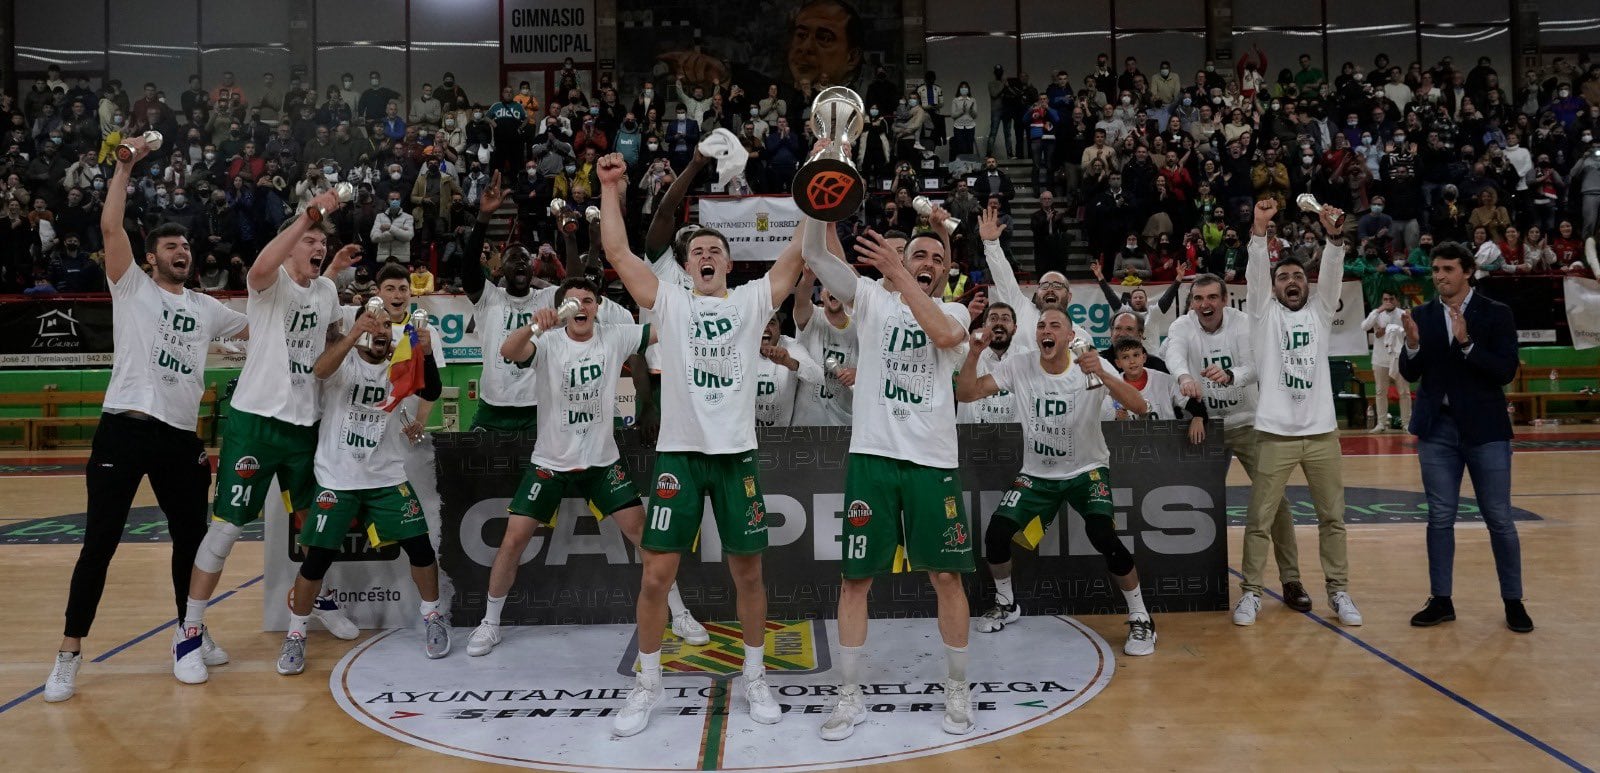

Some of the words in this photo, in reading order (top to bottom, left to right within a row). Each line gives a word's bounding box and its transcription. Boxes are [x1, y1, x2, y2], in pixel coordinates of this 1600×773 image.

[511, 8, 585, 27] GIMNASIO
[510, 34, 592, 53] MUNICIPAL
[705, 221, 756, 229] AYUNTAMIENTO
[694, 346, 732, 358] SOMOS
[888, 326, 928, 362] LEB
[87, 354, 100, 362] 942
[886, 358, 927, 374] SOMOS
[1284, 356, 1315, 366] SOMOS
[693, 358, 734, 388] ORO
[884, 371, 926, 404] ORO
[1035, 397, 1067, 424] LEB
[1034, 424, 1066, 435] SOMOS
[1034, 433, 1067, 457] ORO
[230, 484, 253, 508] 24
[527, 482, 542, 501] 9
[999, 489, 1022, 508] 99
[650, 505, 672, 531] 10
[847, 534, 867, 559] 13
[366, 686, 727, 704] AYUNTAMIETO
[679, 706, 730, 716] EL
